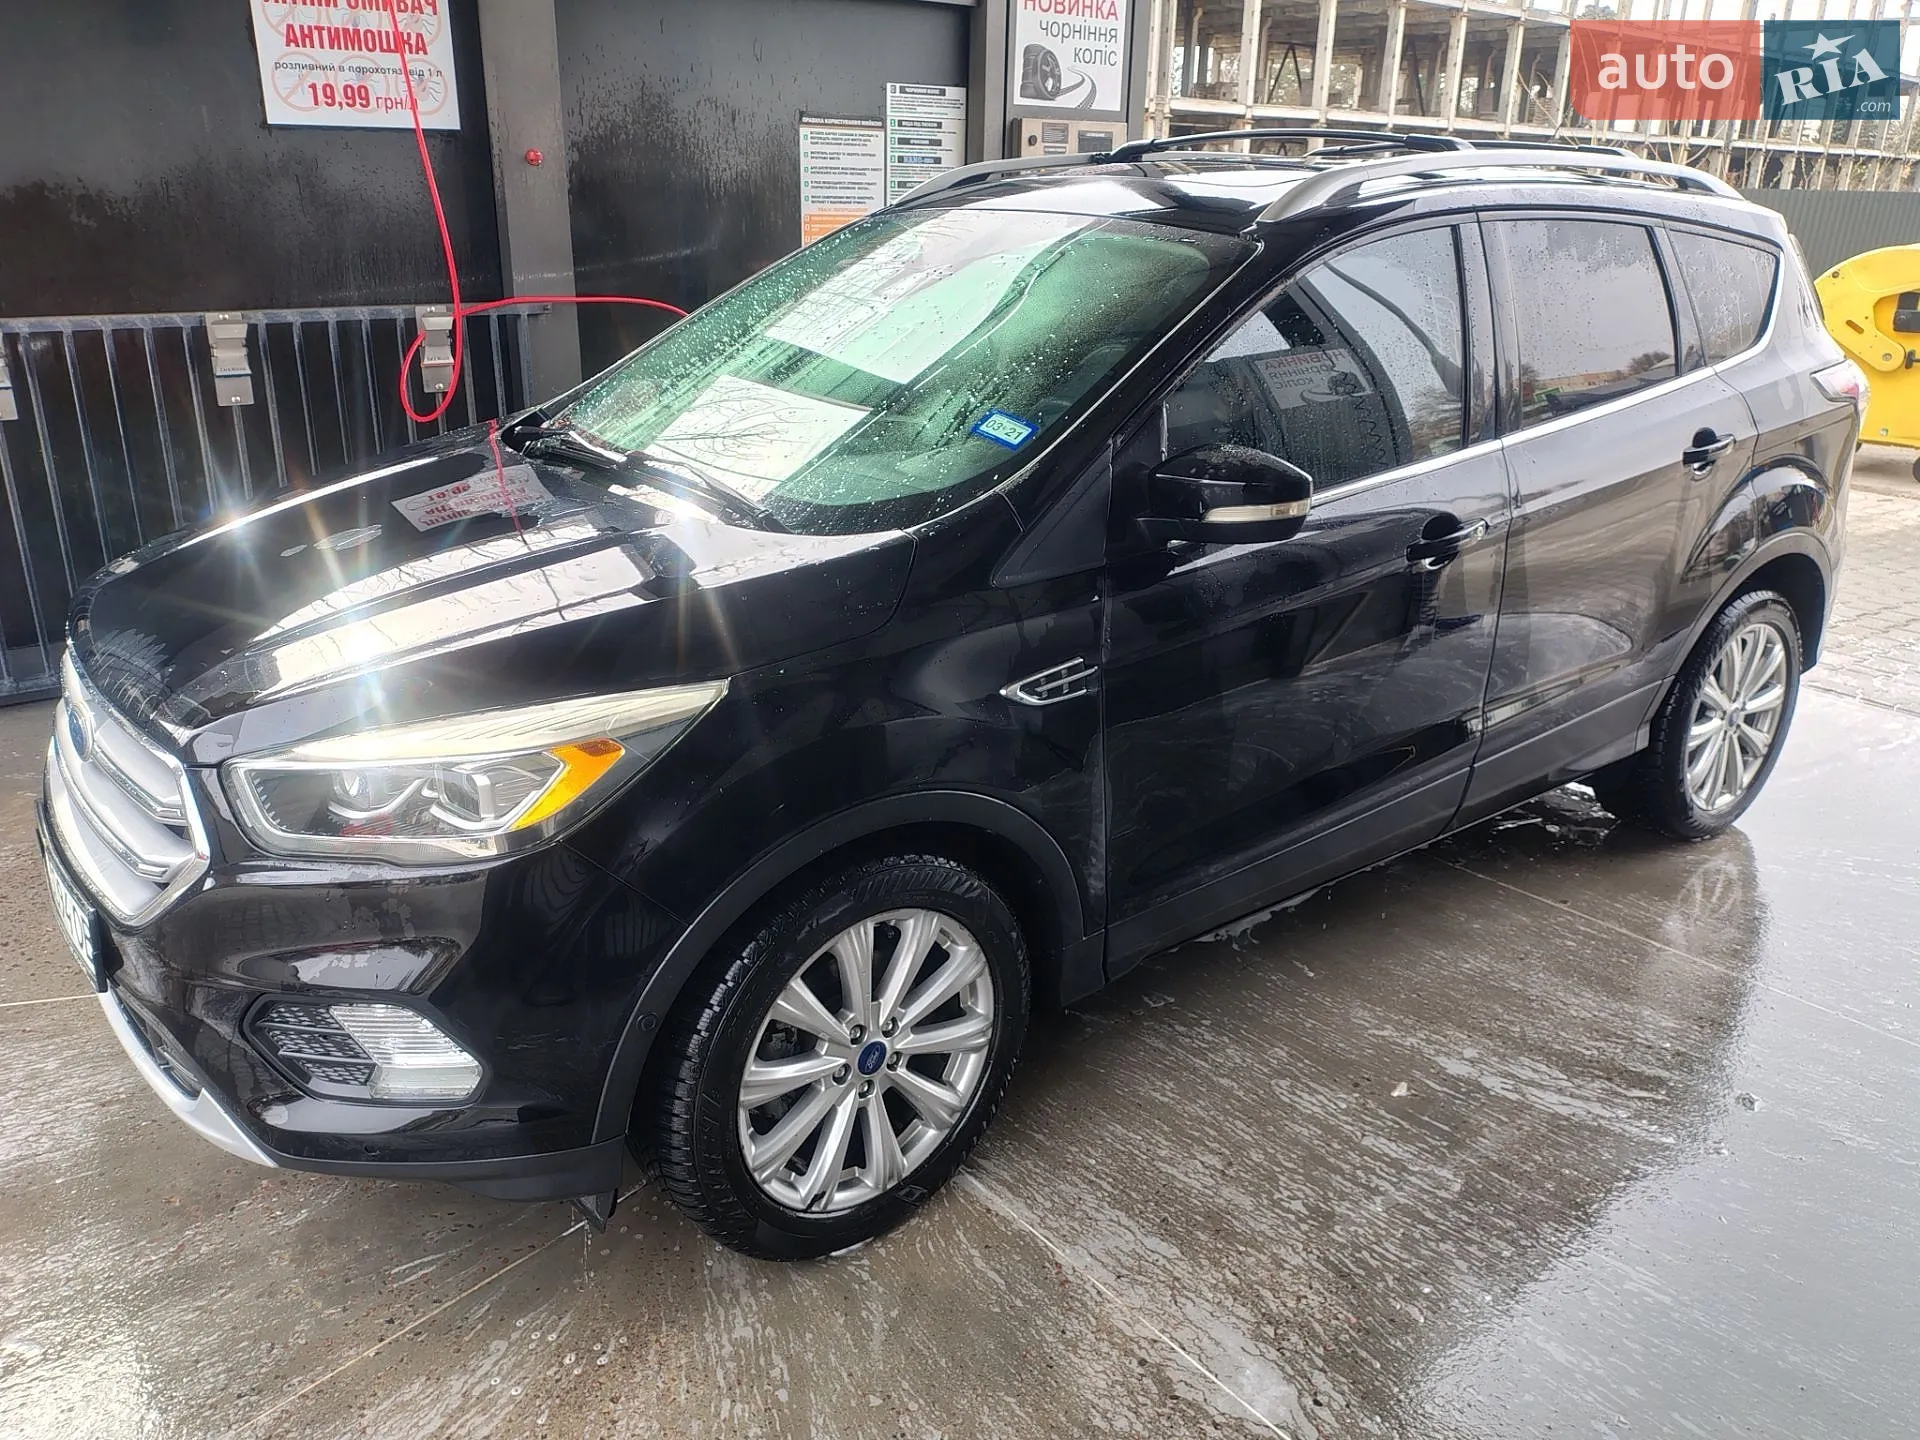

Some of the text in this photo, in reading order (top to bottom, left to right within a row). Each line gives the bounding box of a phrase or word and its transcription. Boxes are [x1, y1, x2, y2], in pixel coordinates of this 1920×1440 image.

[1024, 0, 1119, 21] НОВИНКА
[285, 23, 429, 56] АНТИМОШКА
[1039, 19, 1118, 44] чорніння
[1073, 44, 1118, 67] коліс
[274, 61, 336, 72] розливний
[338, 65, 344, 73] в
[348, 65, 405, 76] порохотяз
[409, 67, 425, 77] від
[308, 82, 370, 111] 19,99
